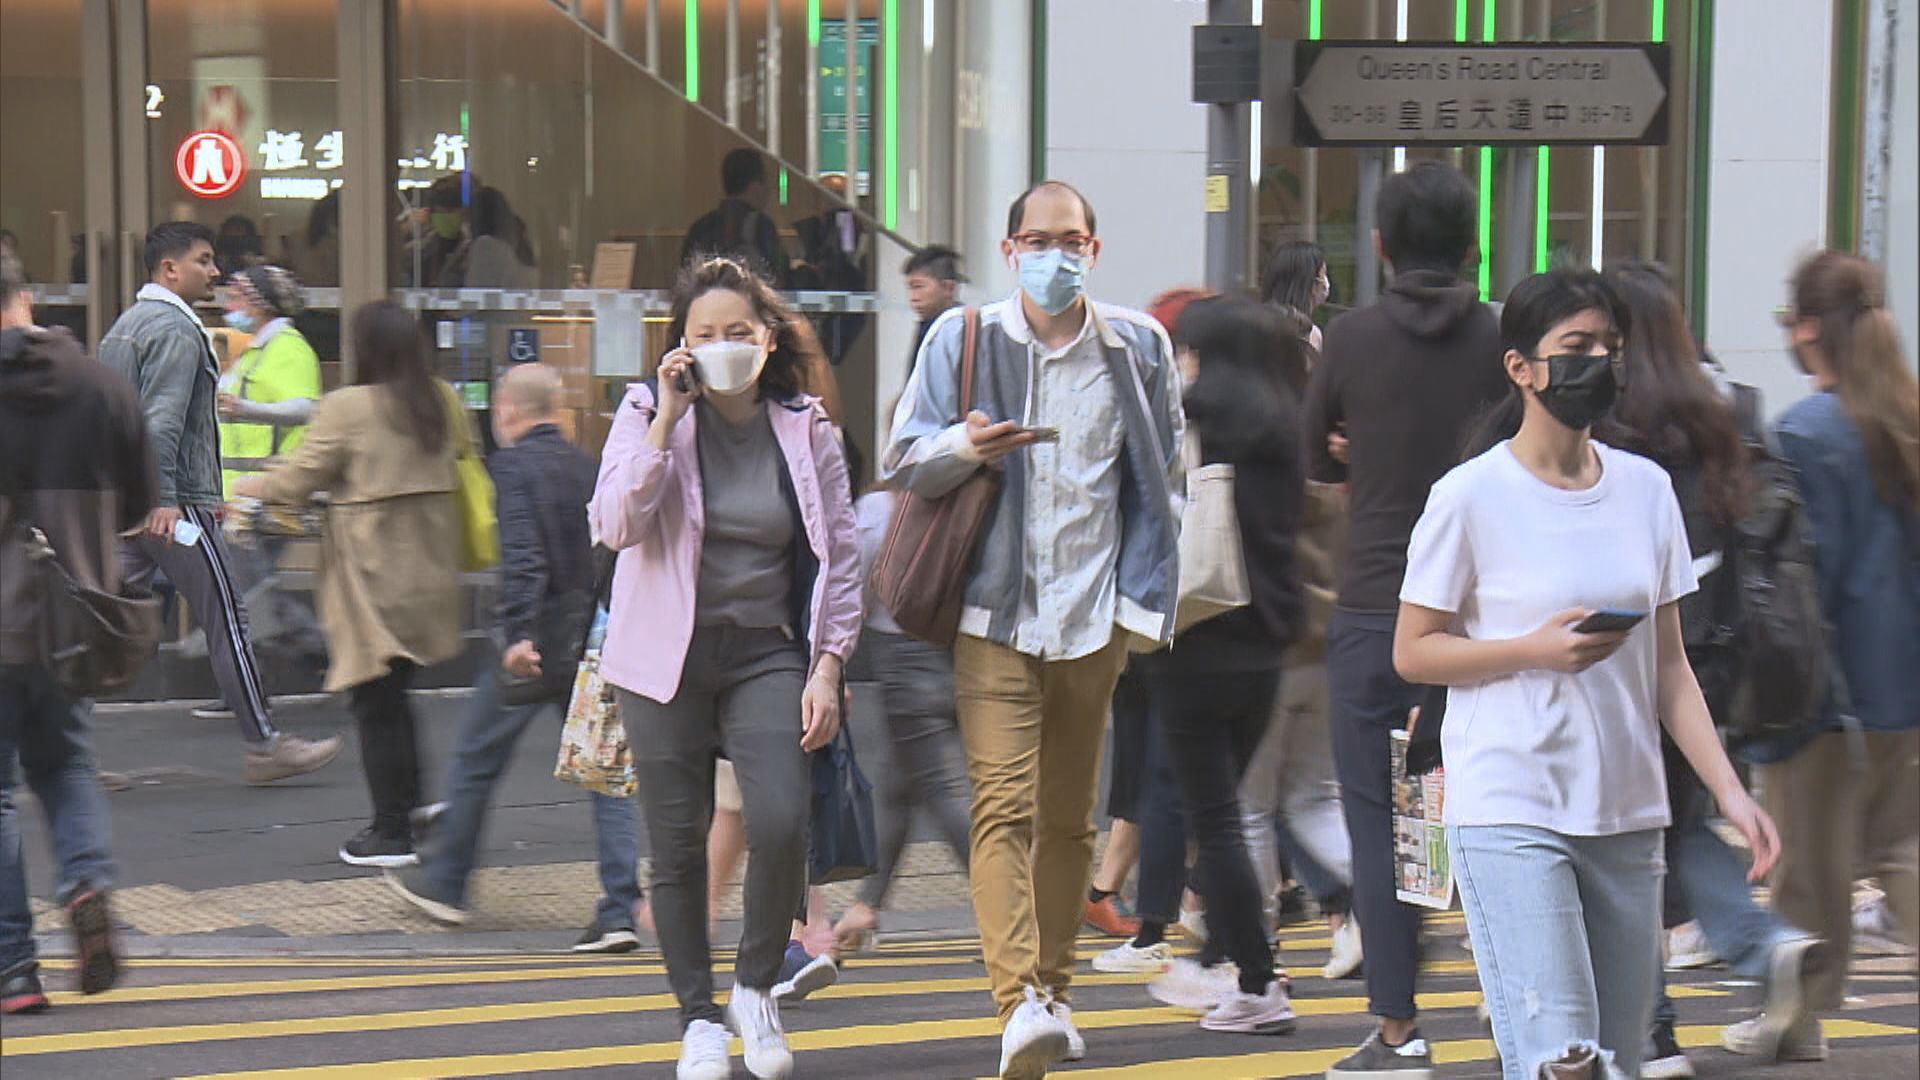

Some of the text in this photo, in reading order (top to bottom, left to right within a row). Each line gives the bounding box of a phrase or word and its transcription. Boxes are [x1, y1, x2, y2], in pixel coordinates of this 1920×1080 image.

[1356, 54, 1611, 81] Queen's Road Central
[1396, 98, 1569, 131] 皇后大道中
